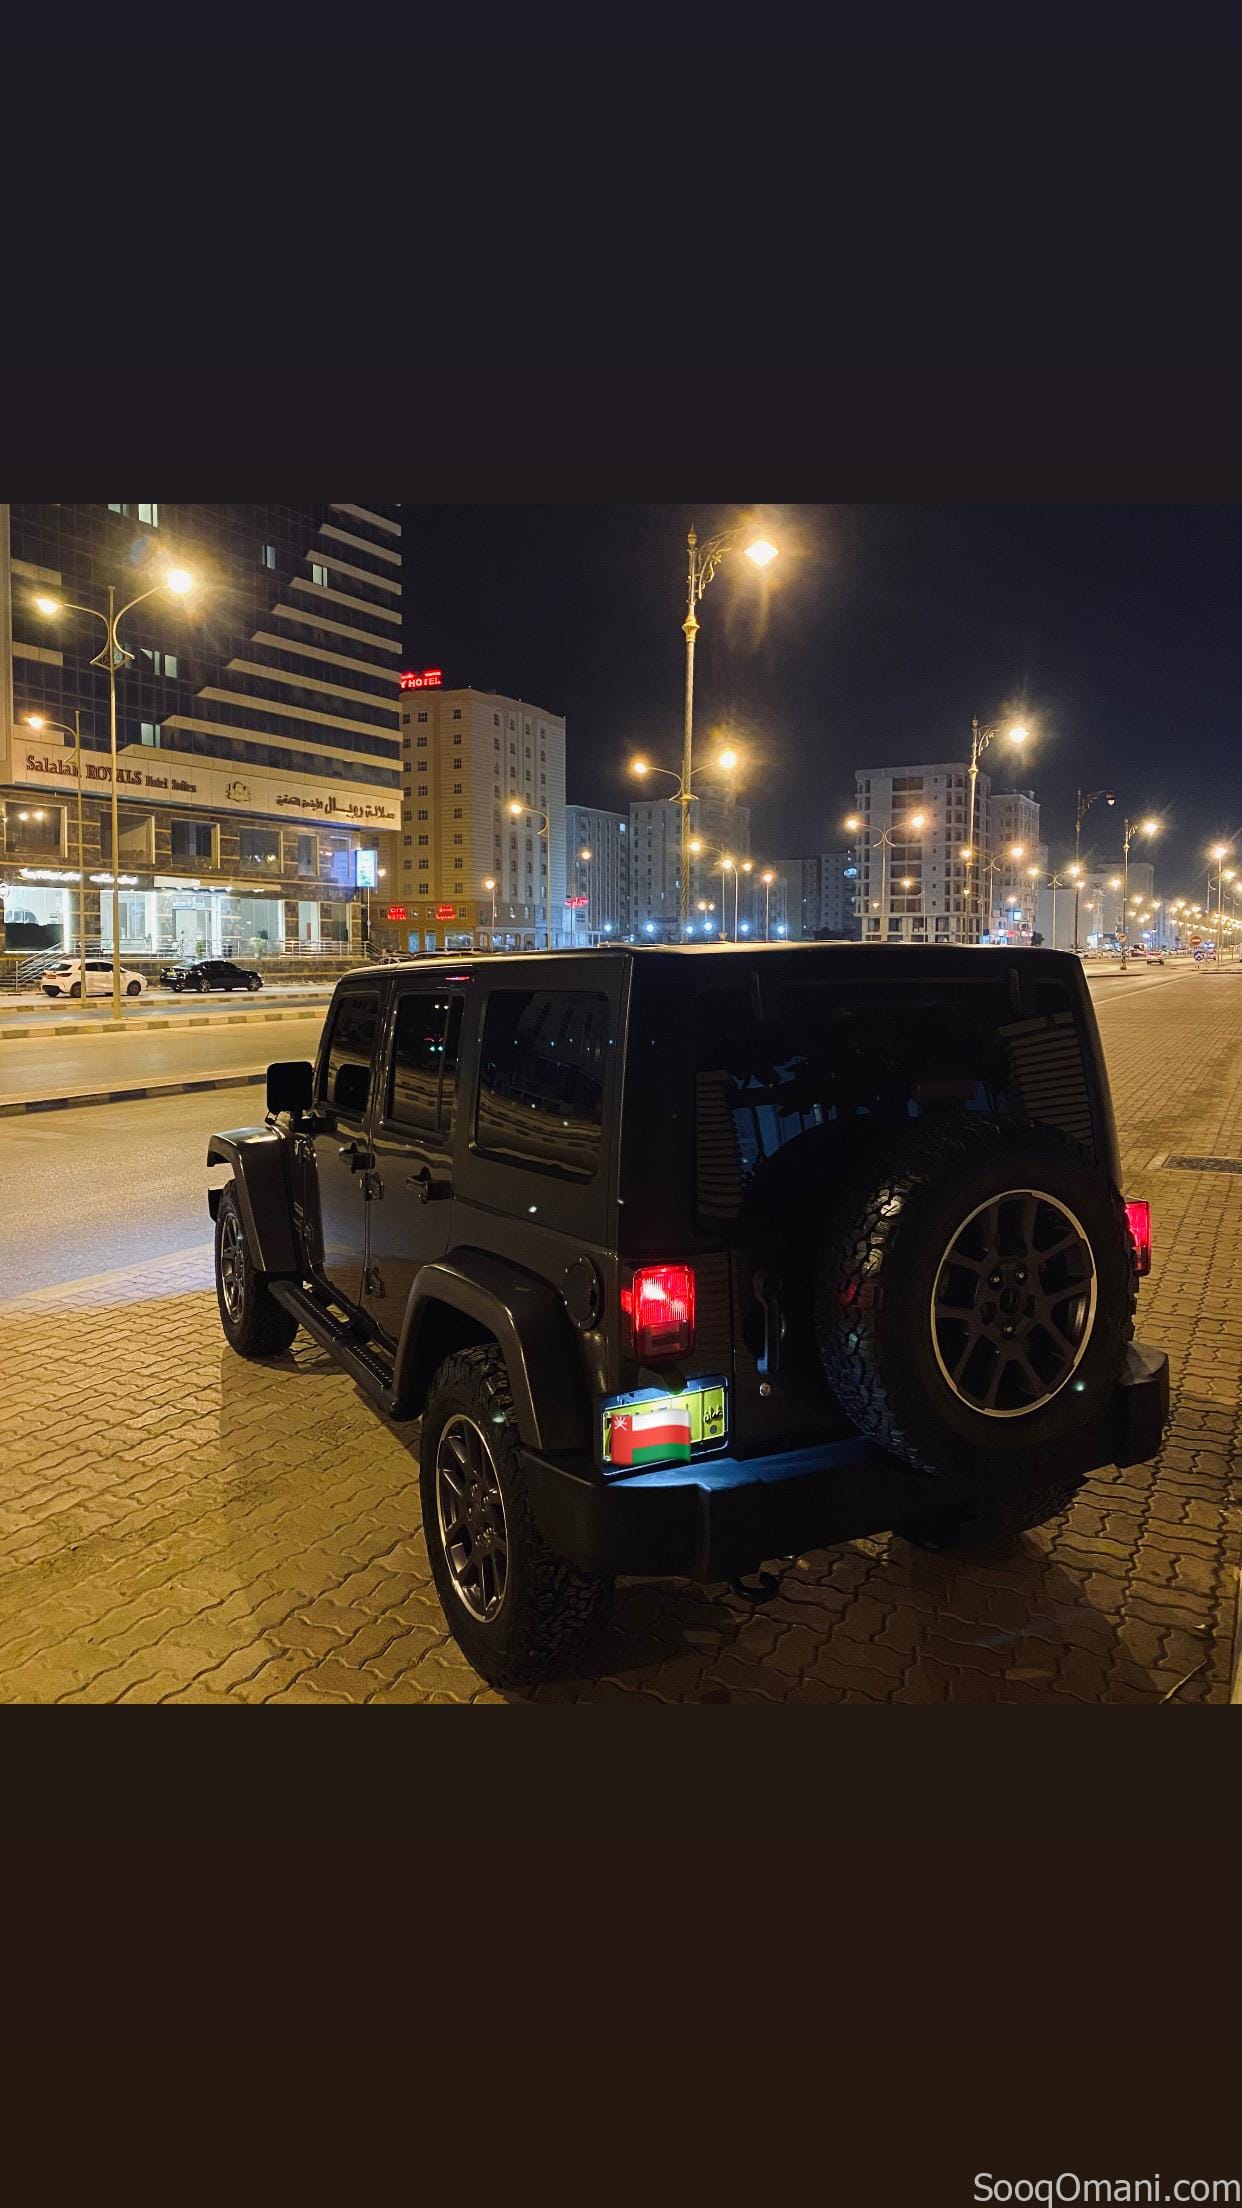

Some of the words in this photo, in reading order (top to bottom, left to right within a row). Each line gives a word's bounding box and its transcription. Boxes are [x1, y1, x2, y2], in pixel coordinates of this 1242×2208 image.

[408, 677, 441, 688] HOTEL
[26, 755, 82, 778] Salalah
[86, 764, 142, 785] ROYALS
